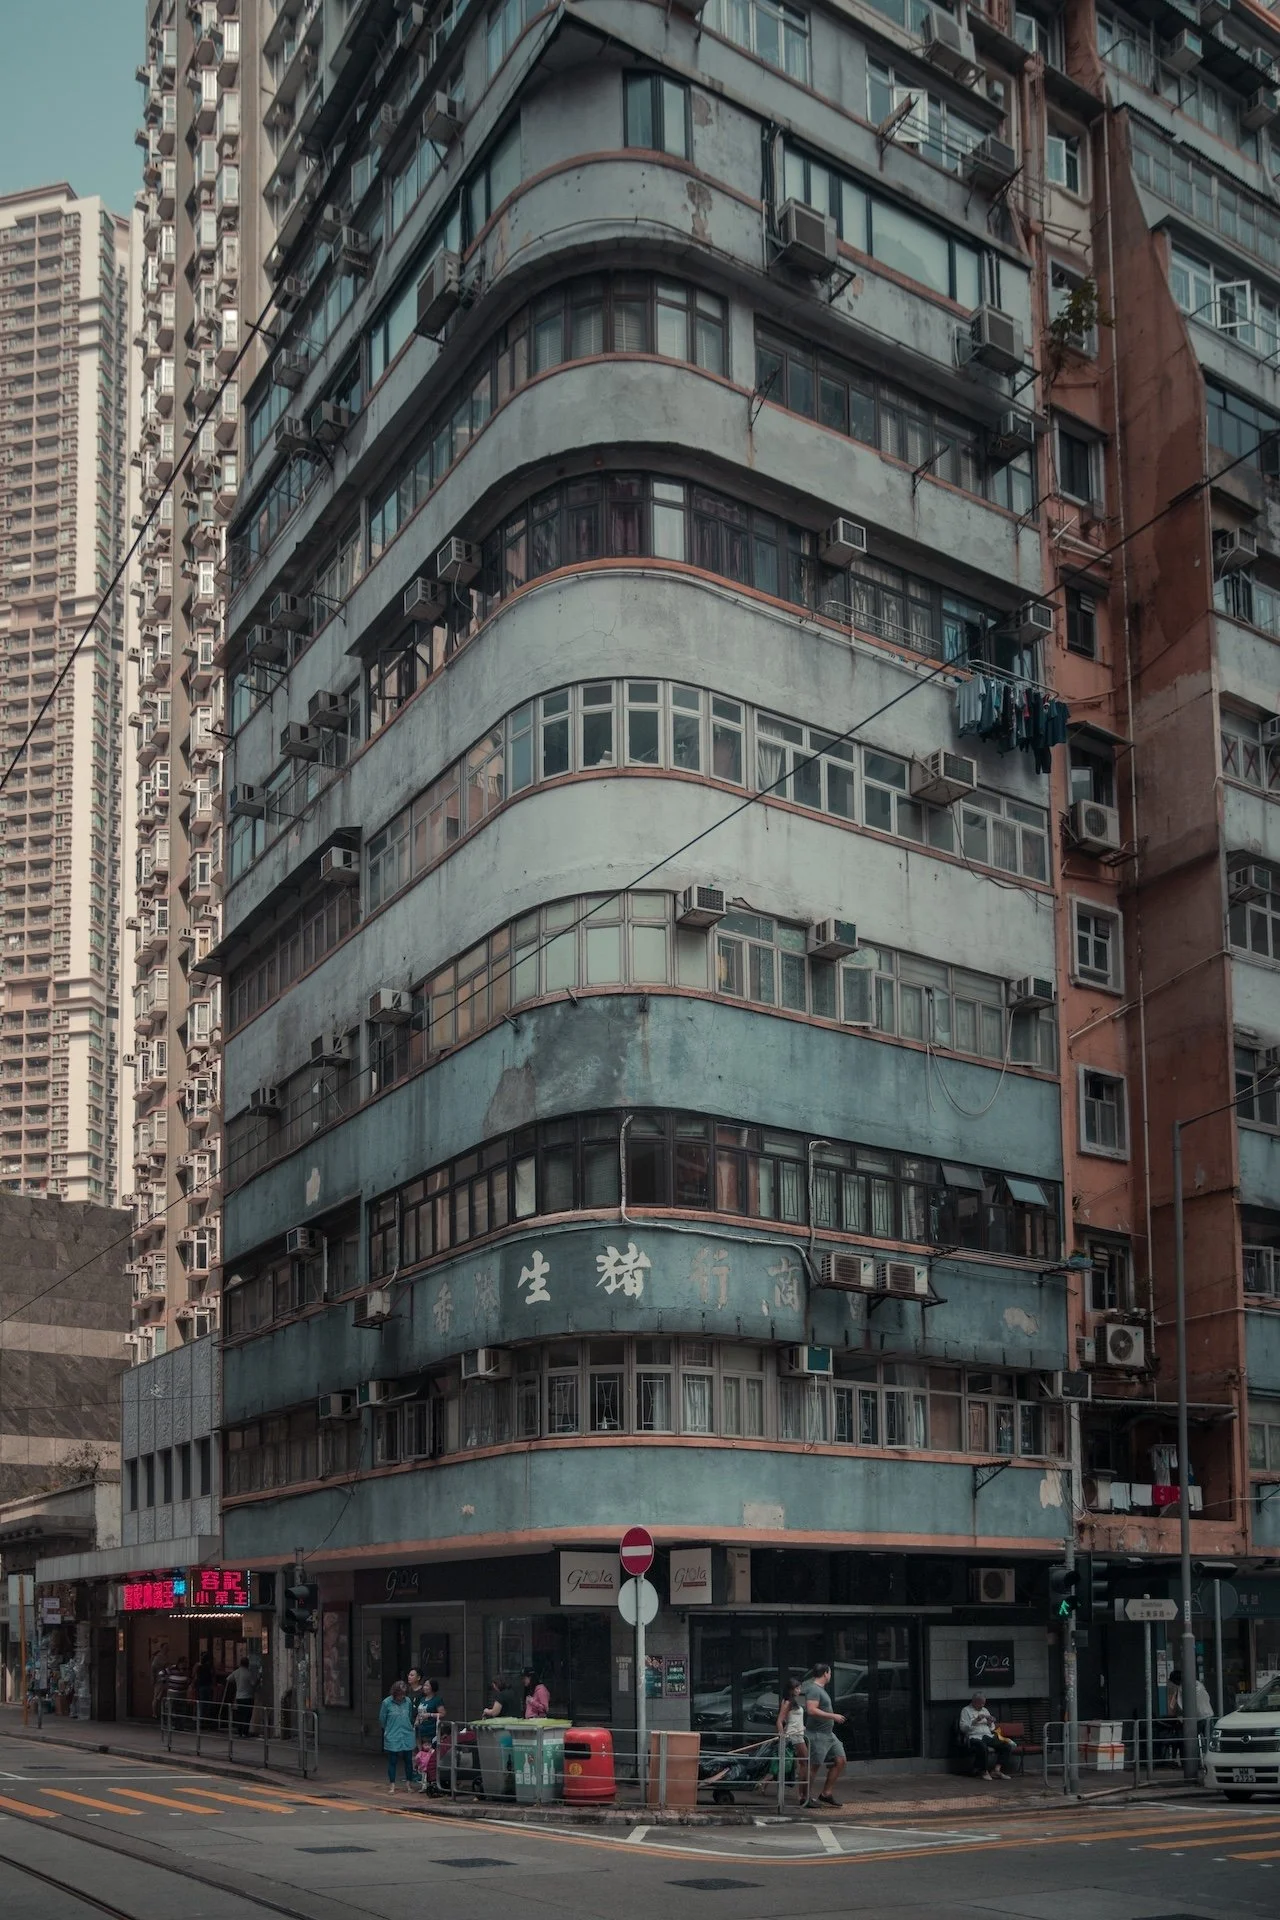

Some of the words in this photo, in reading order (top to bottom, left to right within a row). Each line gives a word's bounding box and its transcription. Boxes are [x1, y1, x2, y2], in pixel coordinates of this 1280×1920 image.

[201, 1571, 241, 1590] 容記
[196, 1591, 247, 1605] 小菜王
